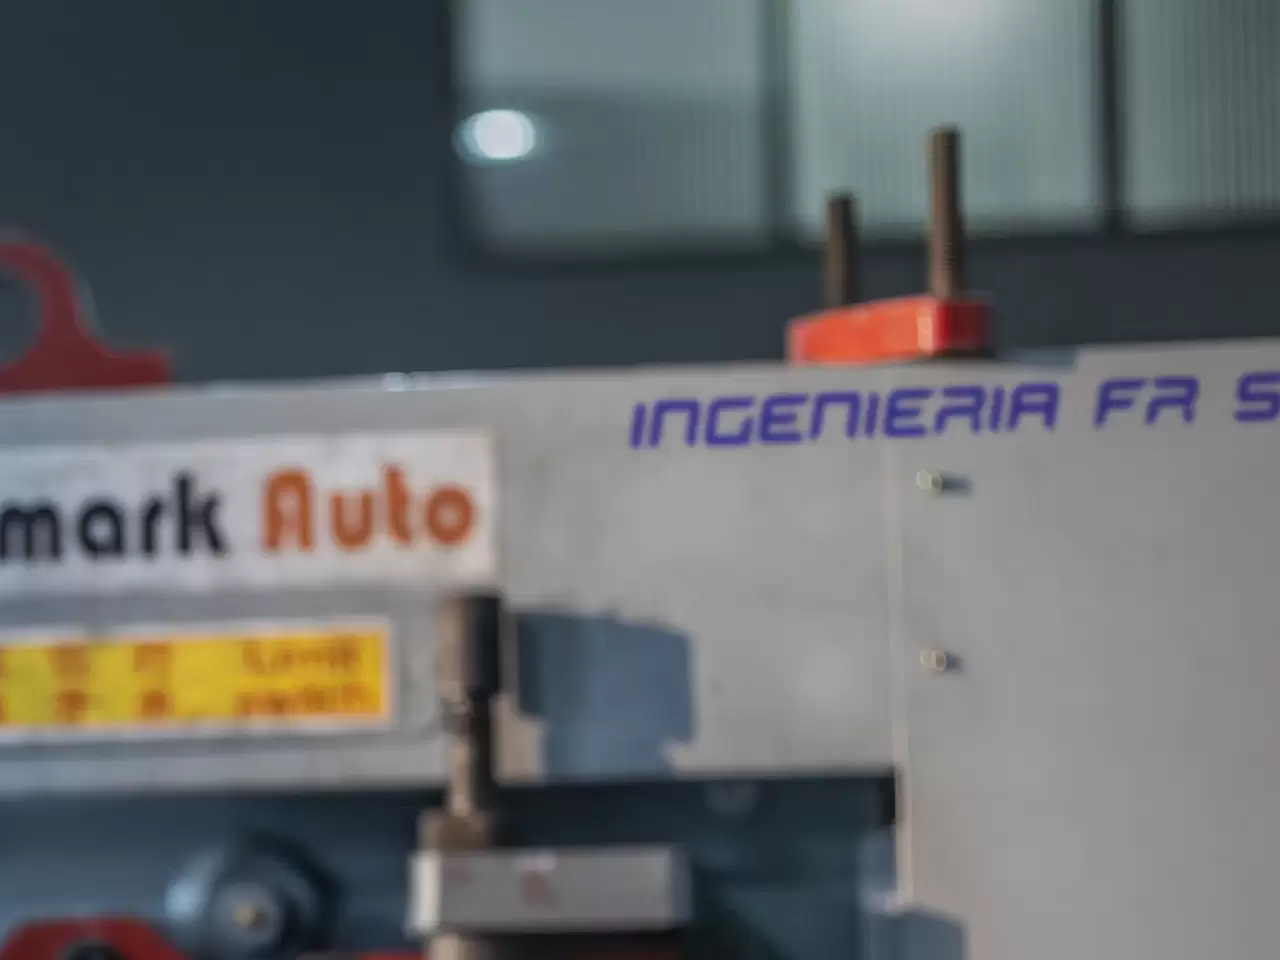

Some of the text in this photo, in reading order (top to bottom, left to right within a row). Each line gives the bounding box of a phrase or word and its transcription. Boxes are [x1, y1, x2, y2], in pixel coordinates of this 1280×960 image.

[628, 381, 1061, 450] INGENIERIA
[1092, 374, 1201, 428] FR
[262, 465, 480, 553] Auto
